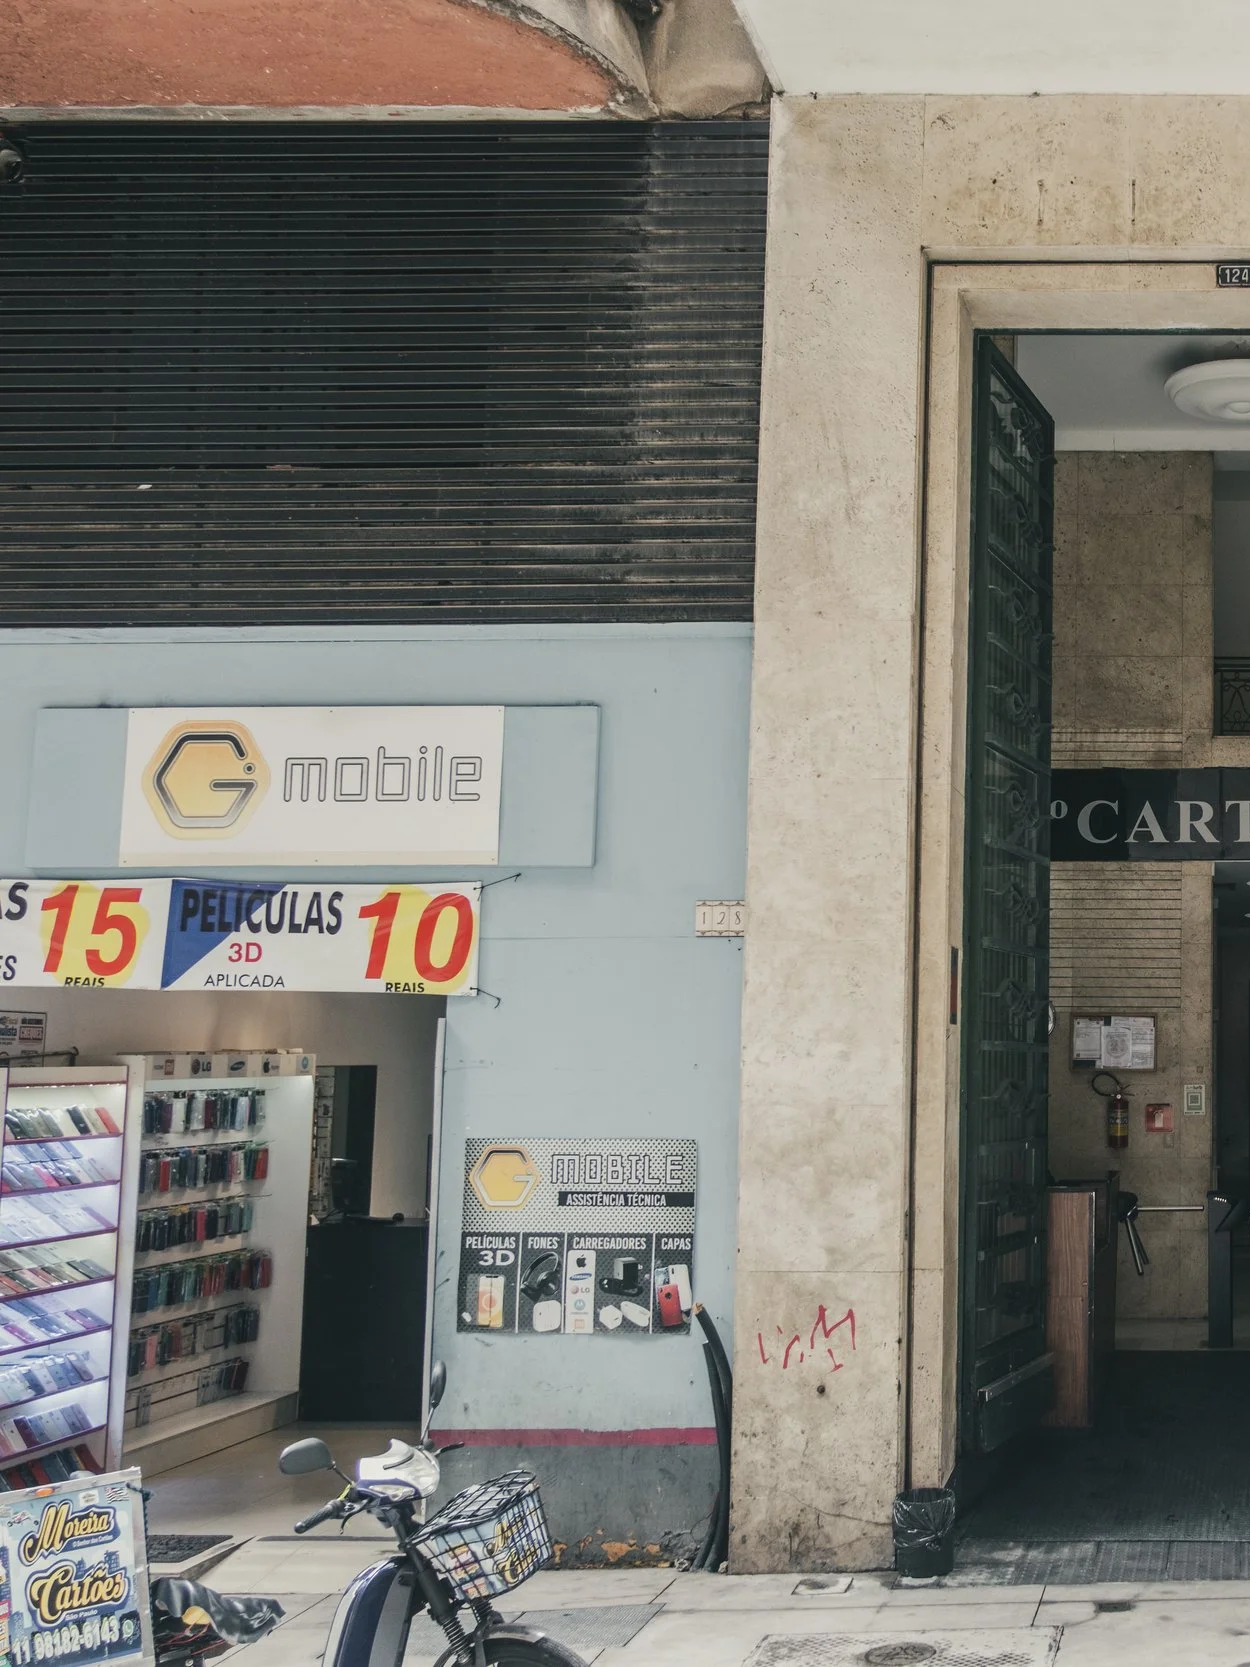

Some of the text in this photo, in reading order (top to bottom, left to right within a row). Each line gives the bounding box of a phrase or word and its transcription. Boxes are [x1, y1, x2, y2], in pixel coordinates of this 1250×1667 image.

[1225, 269, 1248, 283] 124
[283, 746, 483, 803] mobile
[702, 911, 741, 925] 128
[41, 884, 143, 977] 15
[358, 892, 474, 983] 10
[227, 941, 263, 963] 3D
[64, 977, 104, 987] REAIS
[204, 974, 286, 988] APLICADA
[385, 982, 425, 993] REAIS
[551, 1154, 684, 1185] MOBILE
[566, 1191, 667, 1206] ASSISTÊNCIA TÉCNICA
[465, 1234, 516, 1250] PELÍCULAS
[527, 1236, 559, 1249] FONES
[572, 1236, 647, 1250] CARREGADORES
[661, 1237, 692, 1250] CAPAS
[478, 1250, 515, 1266] 3D
[25, 1503, 110, 1562] Moreira
[30, 1564, 126, 1622] Cartões
